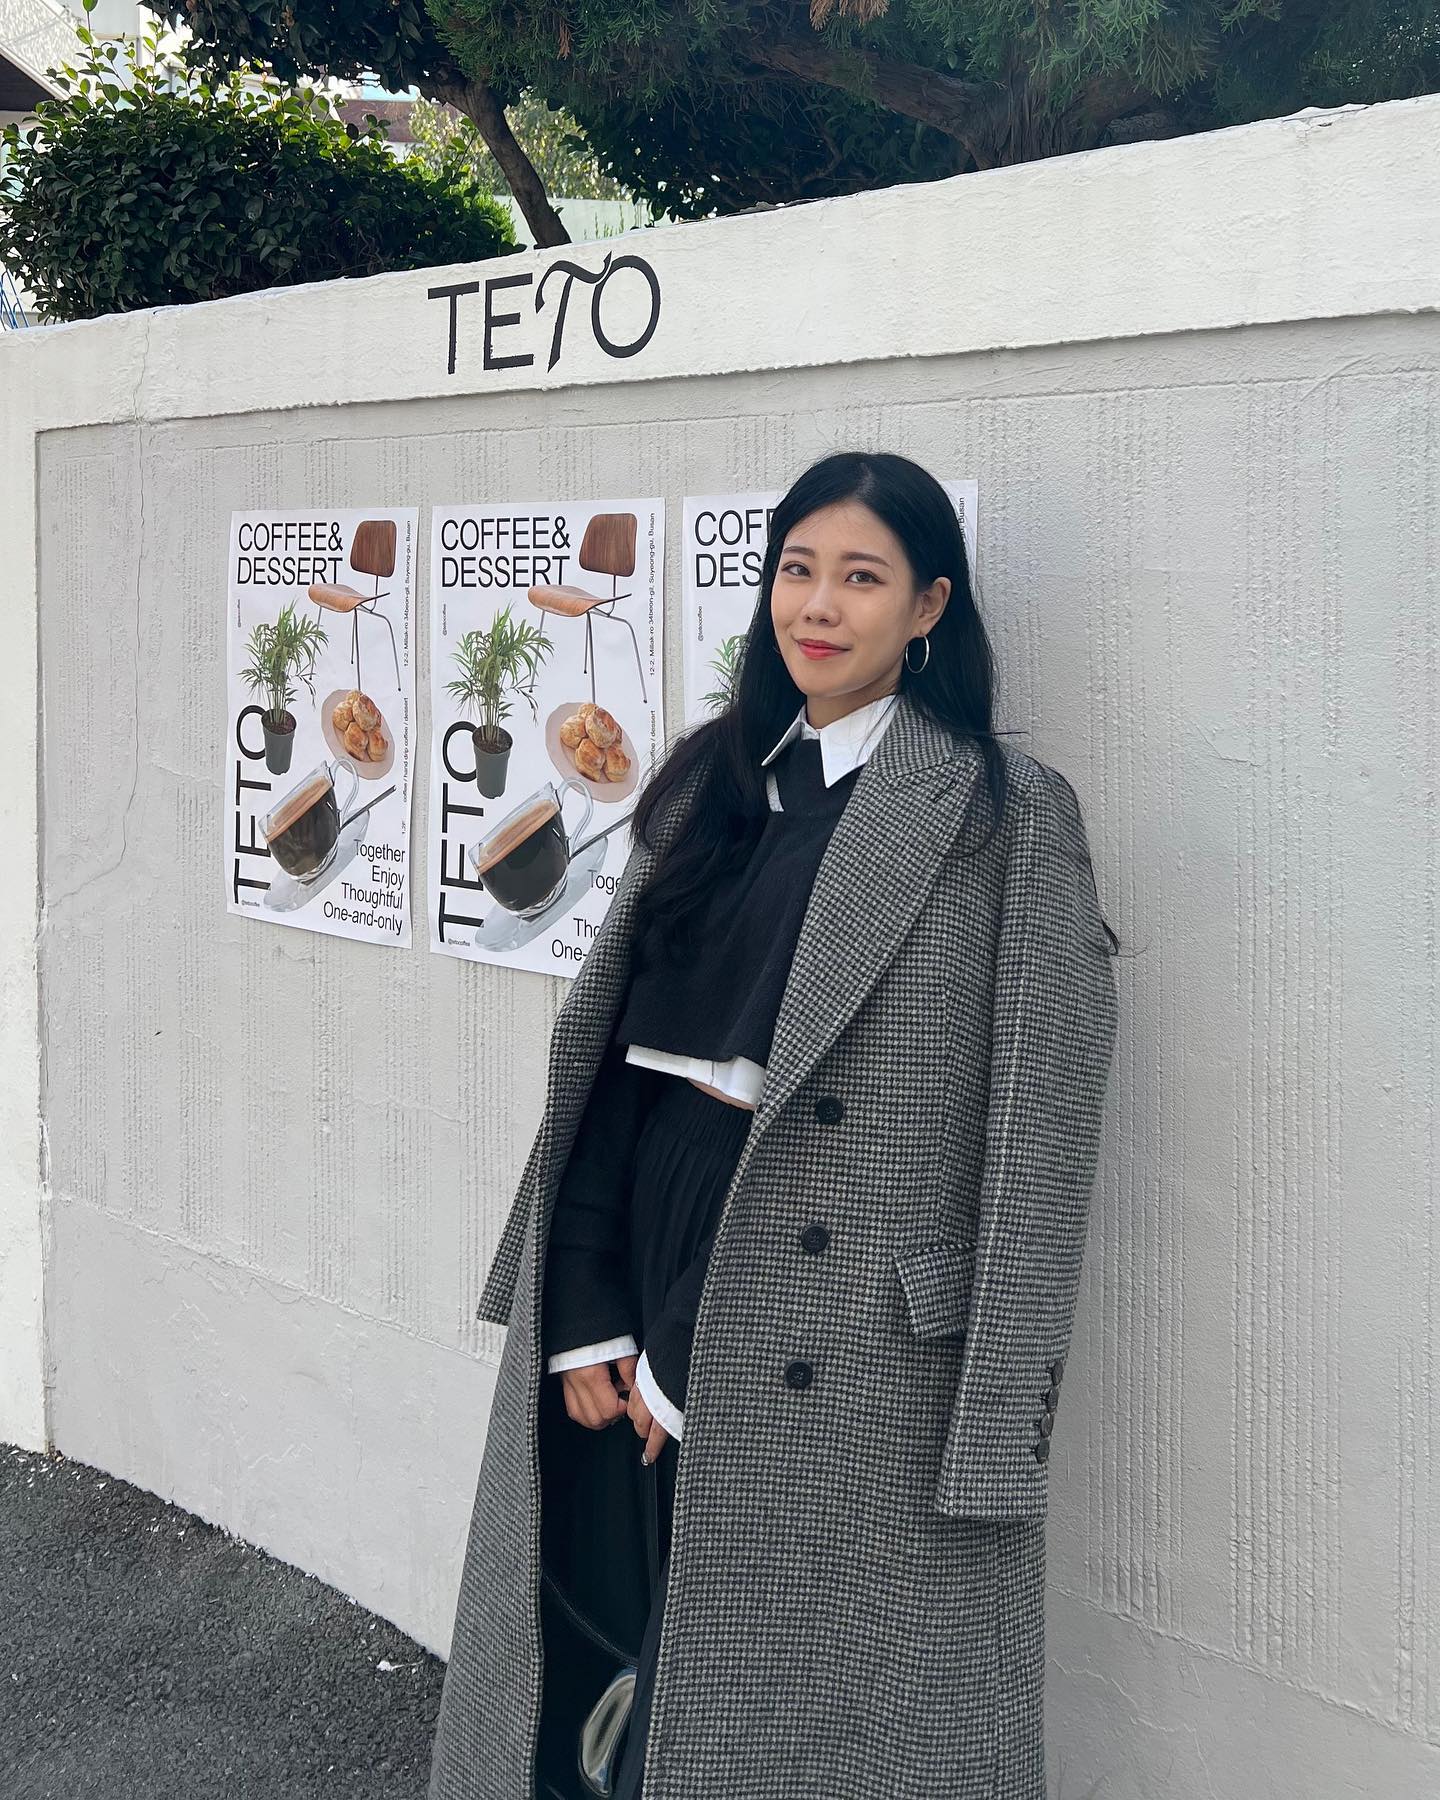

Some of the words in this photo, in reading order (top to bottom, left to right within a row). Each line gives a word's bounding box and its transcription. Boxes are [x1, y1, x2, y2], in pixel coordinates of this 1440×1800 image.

[428, 251, 661, 374] TETO
[238, 522, 344, 551] COFFEE&
[441, 516, 571, 551] COFFEE&
[237, 557, 343, 585] DESSERT
[441, 556, 570, 588] DESSERT
[234, 705, 271, 904] TETO
[439, 721, 484, 943] TETO
[353, 839, 405, 863] Together
[372, 865, 404, 890] Enjoy
[341, 882, 403, 910] Thoughtful
[324, 902, 402, 935] One-and-only
